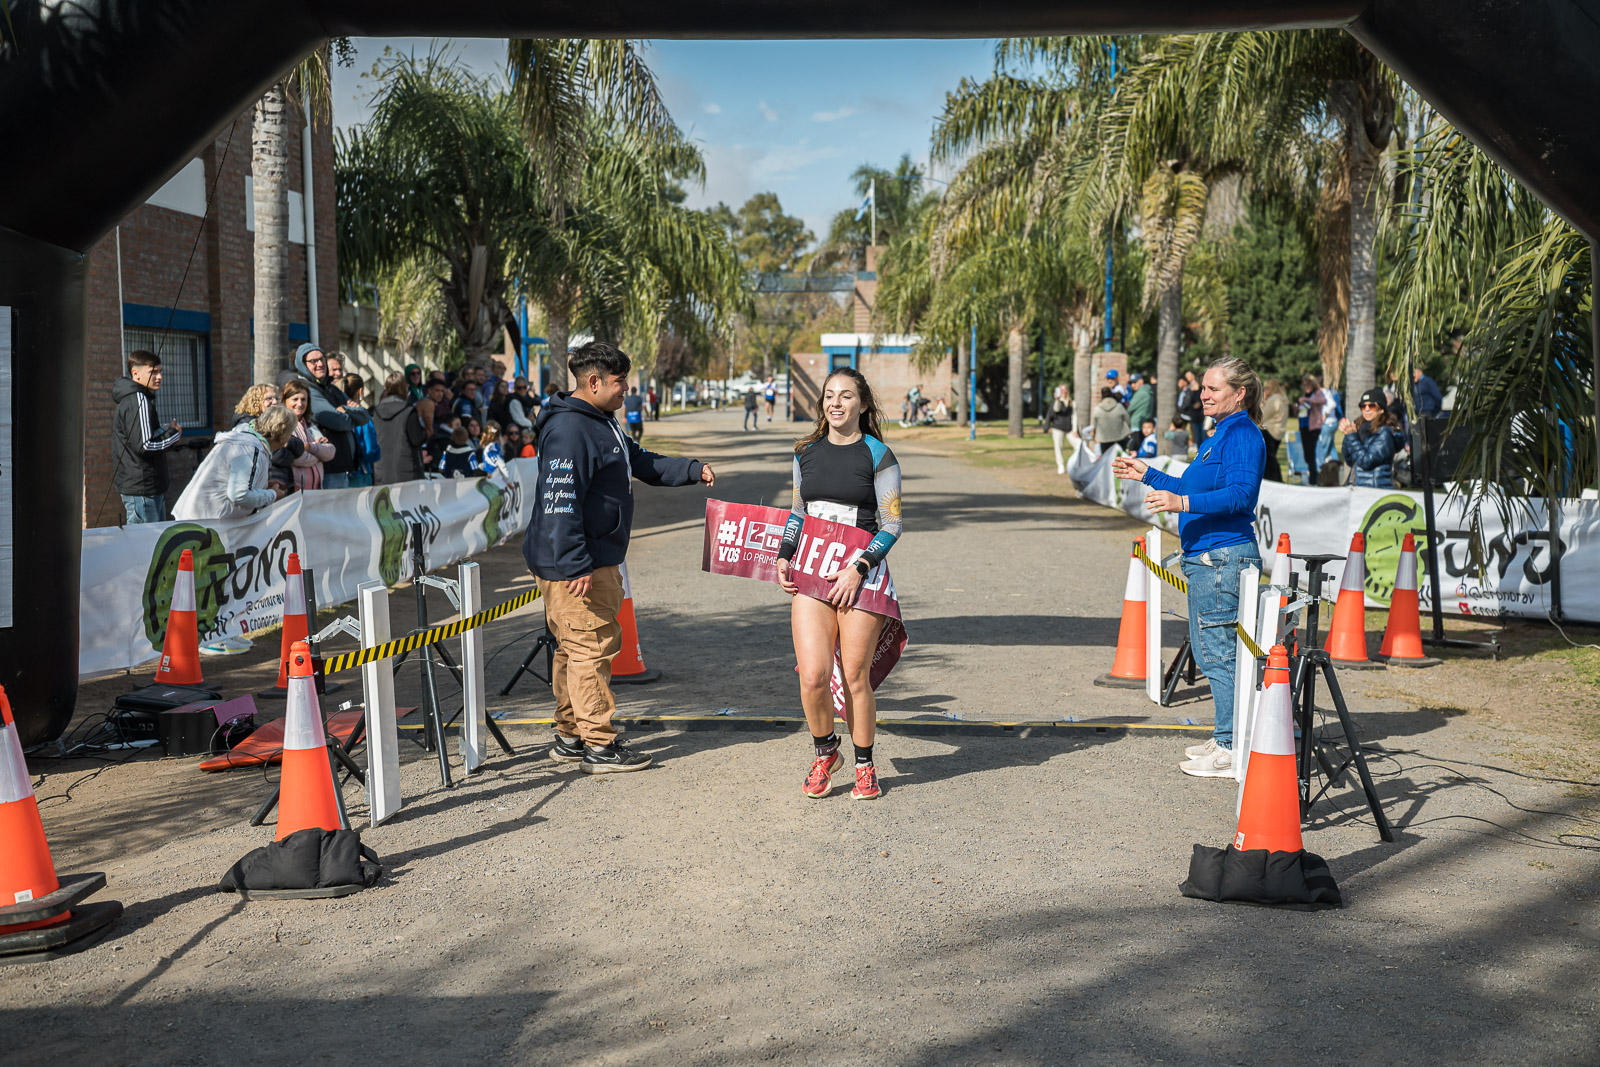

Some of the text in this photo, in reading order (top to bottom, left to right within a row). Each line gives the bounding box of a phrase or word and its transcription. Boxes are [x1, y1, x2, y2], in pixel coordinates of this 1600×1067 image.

[549, 458, 574, 471] El club
[717, 517, 747, 546] #1
[718, 546, 740, 563] VOS
[743, 552, 753, 561] LO
[753, 552, 778, 566] PRIME
